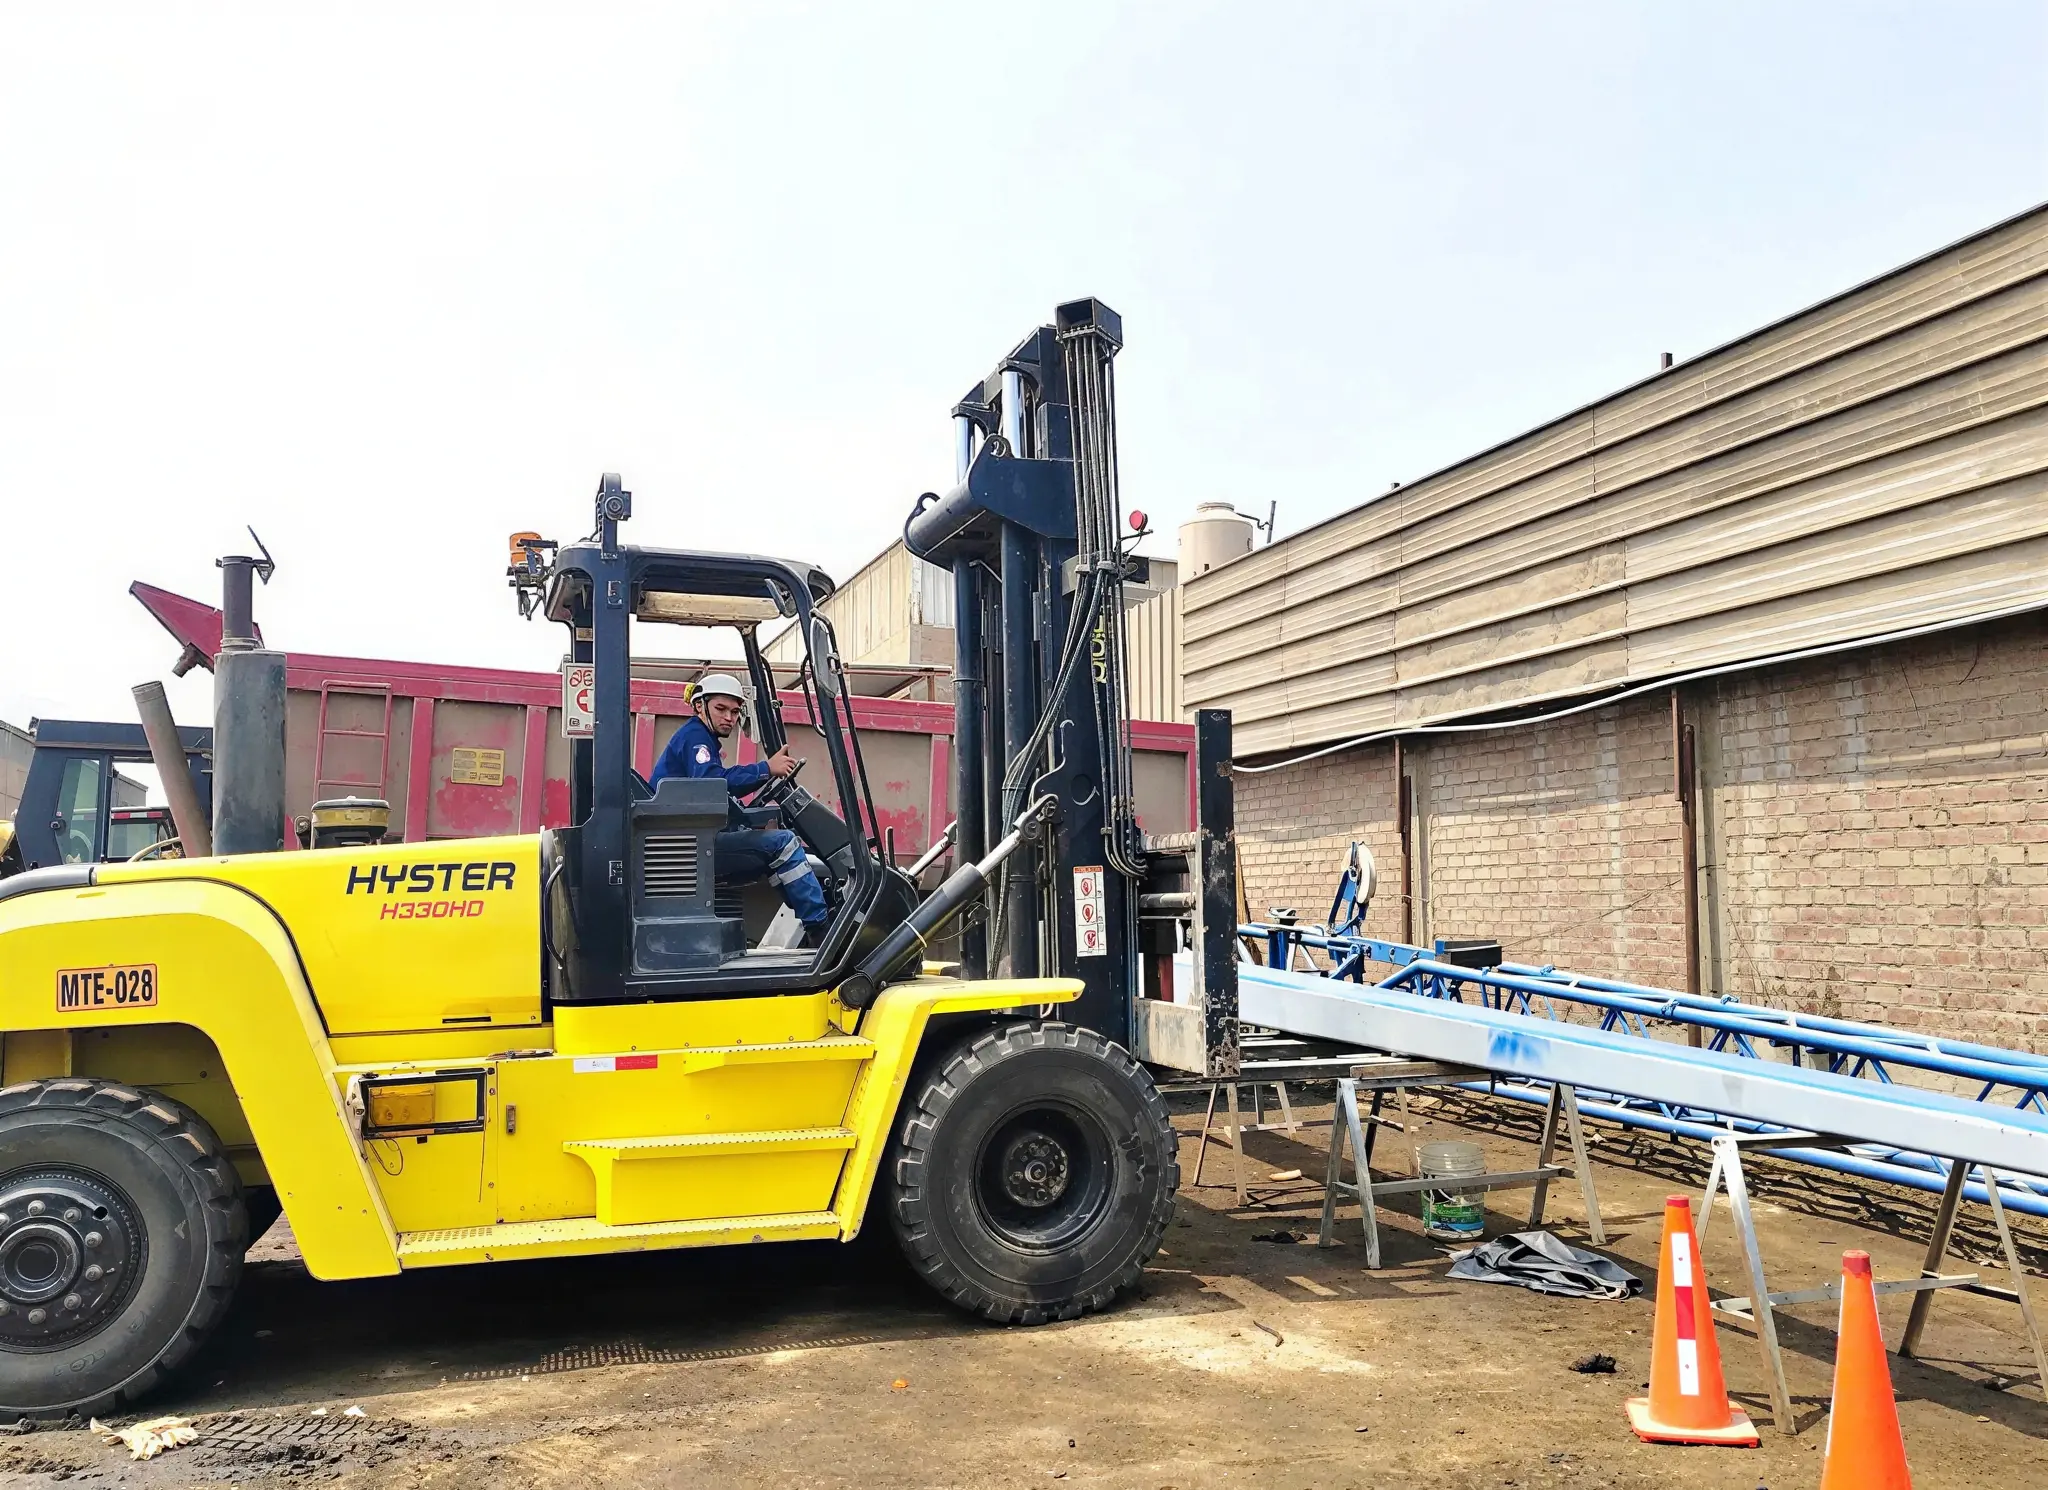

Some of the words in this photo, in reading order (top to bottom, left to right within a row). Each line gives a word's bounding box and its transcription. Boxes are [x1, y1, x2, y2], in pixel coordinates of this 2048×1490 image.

[346, 862, 516, 894] HYSTER
[380, 900, 485, 920] H330HD
[61, 969, 153, 1007] MTE-028
